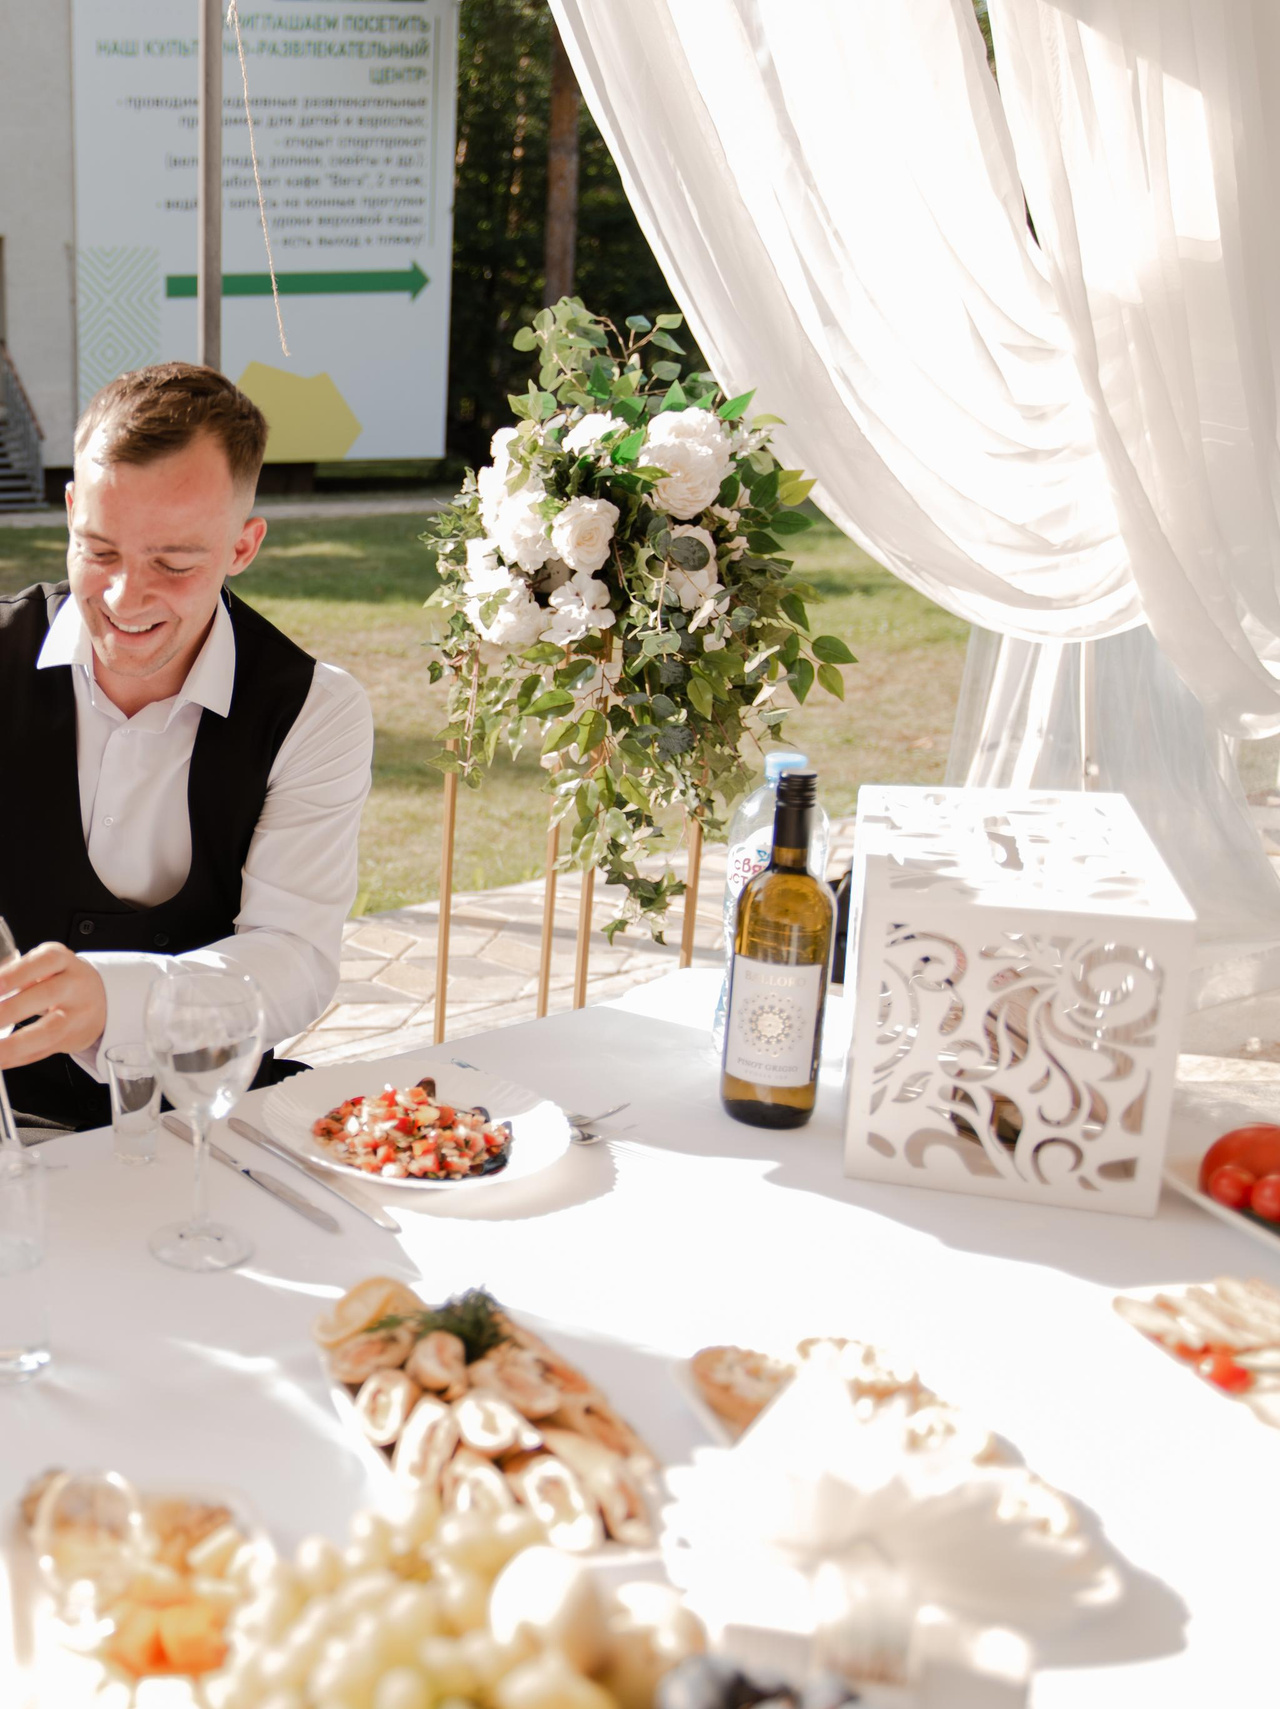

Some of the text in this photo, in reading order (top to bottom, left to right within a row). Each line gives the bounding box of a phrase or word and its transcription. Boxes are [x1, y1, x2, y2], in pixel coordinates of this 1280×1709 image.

[342, 14, 430, 33] ПОСЕТИТЬ
[96, 38, 430, 58] НАШ КУЛЬТНО-РАЗВЛЕКАТЕЛЬНЫЙ
[737, 1056, 799, 1073] PINOT GRIGIO
